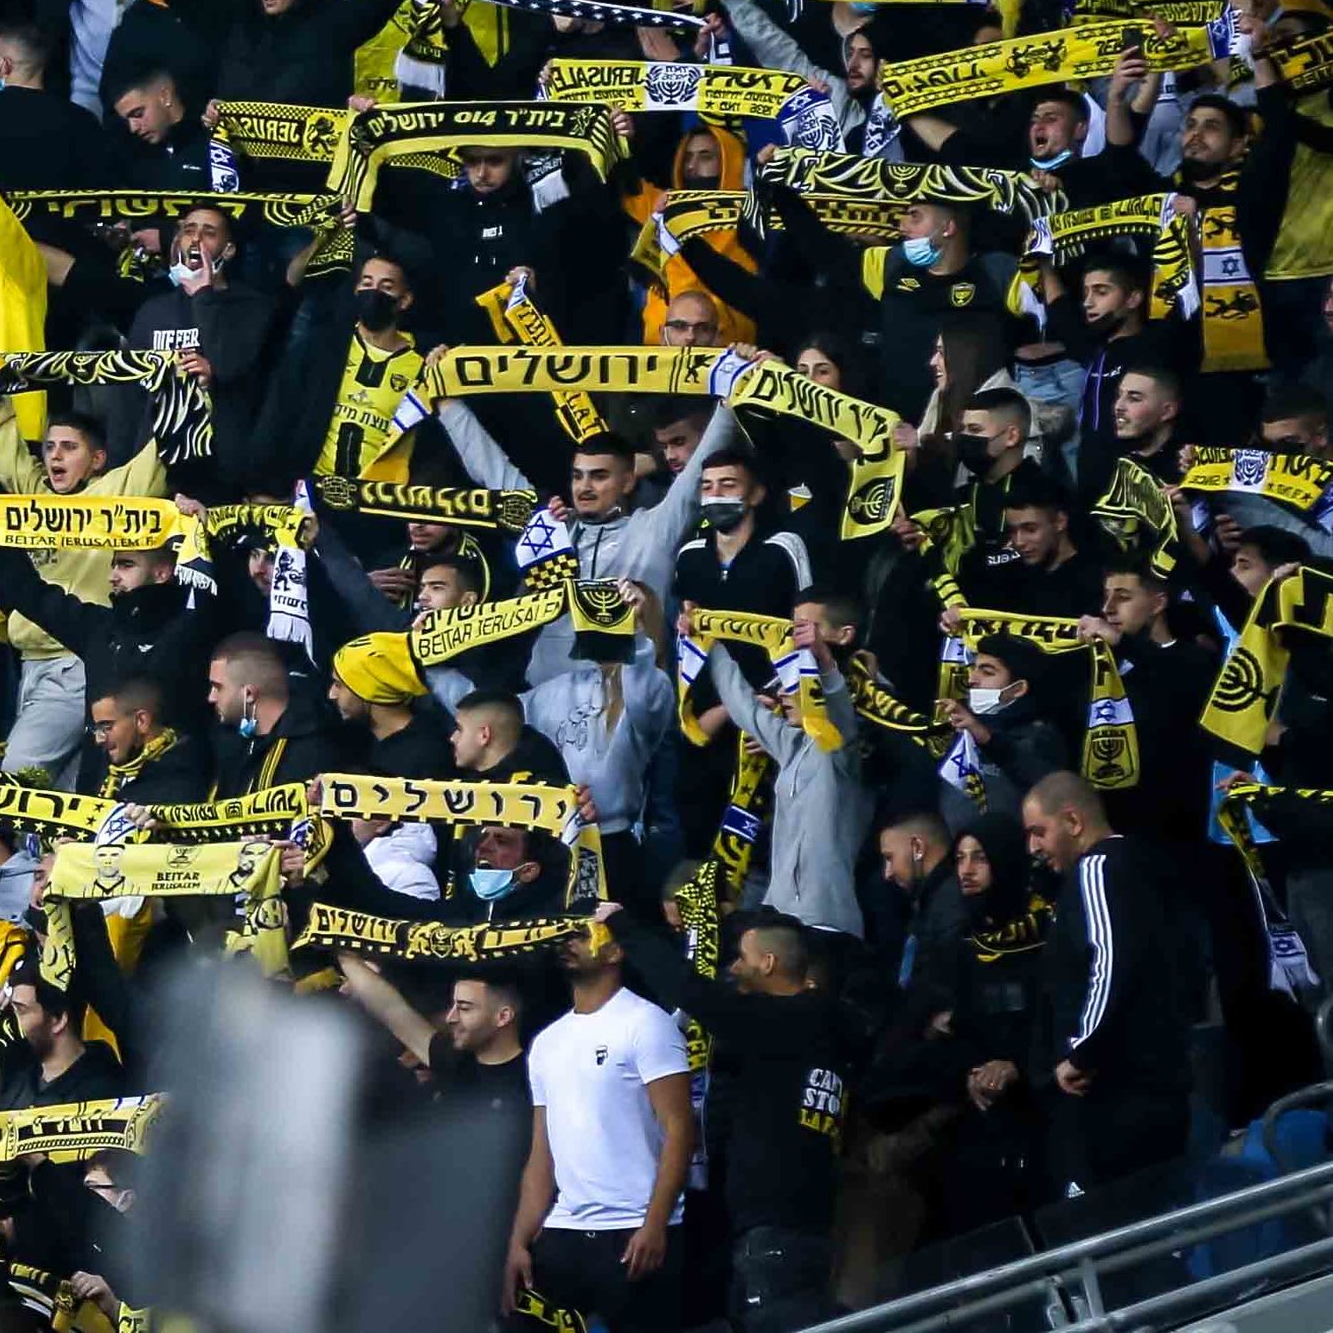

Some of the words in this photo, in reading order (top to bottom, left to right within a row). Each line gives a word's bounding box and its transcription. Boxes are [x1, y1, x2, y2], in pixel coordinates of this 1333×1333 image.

[370, 115, 446, 137] ירושלים
[455, 350, 659, 388] ירושלים
[5, 503, 93, 533] ירושלים
[101, 505, 162, 533] בית"ר
[5, 535, 57, 547] BEITAR
[60, 536, 141, 550] JERUSALEM
[418, 621, 473, 660] BEITAR
[331, 780, 568, 821] ירושלים
[151, 882, 200, 892] JERUSALEM
[156, 871, 200, 882] BEITAR
